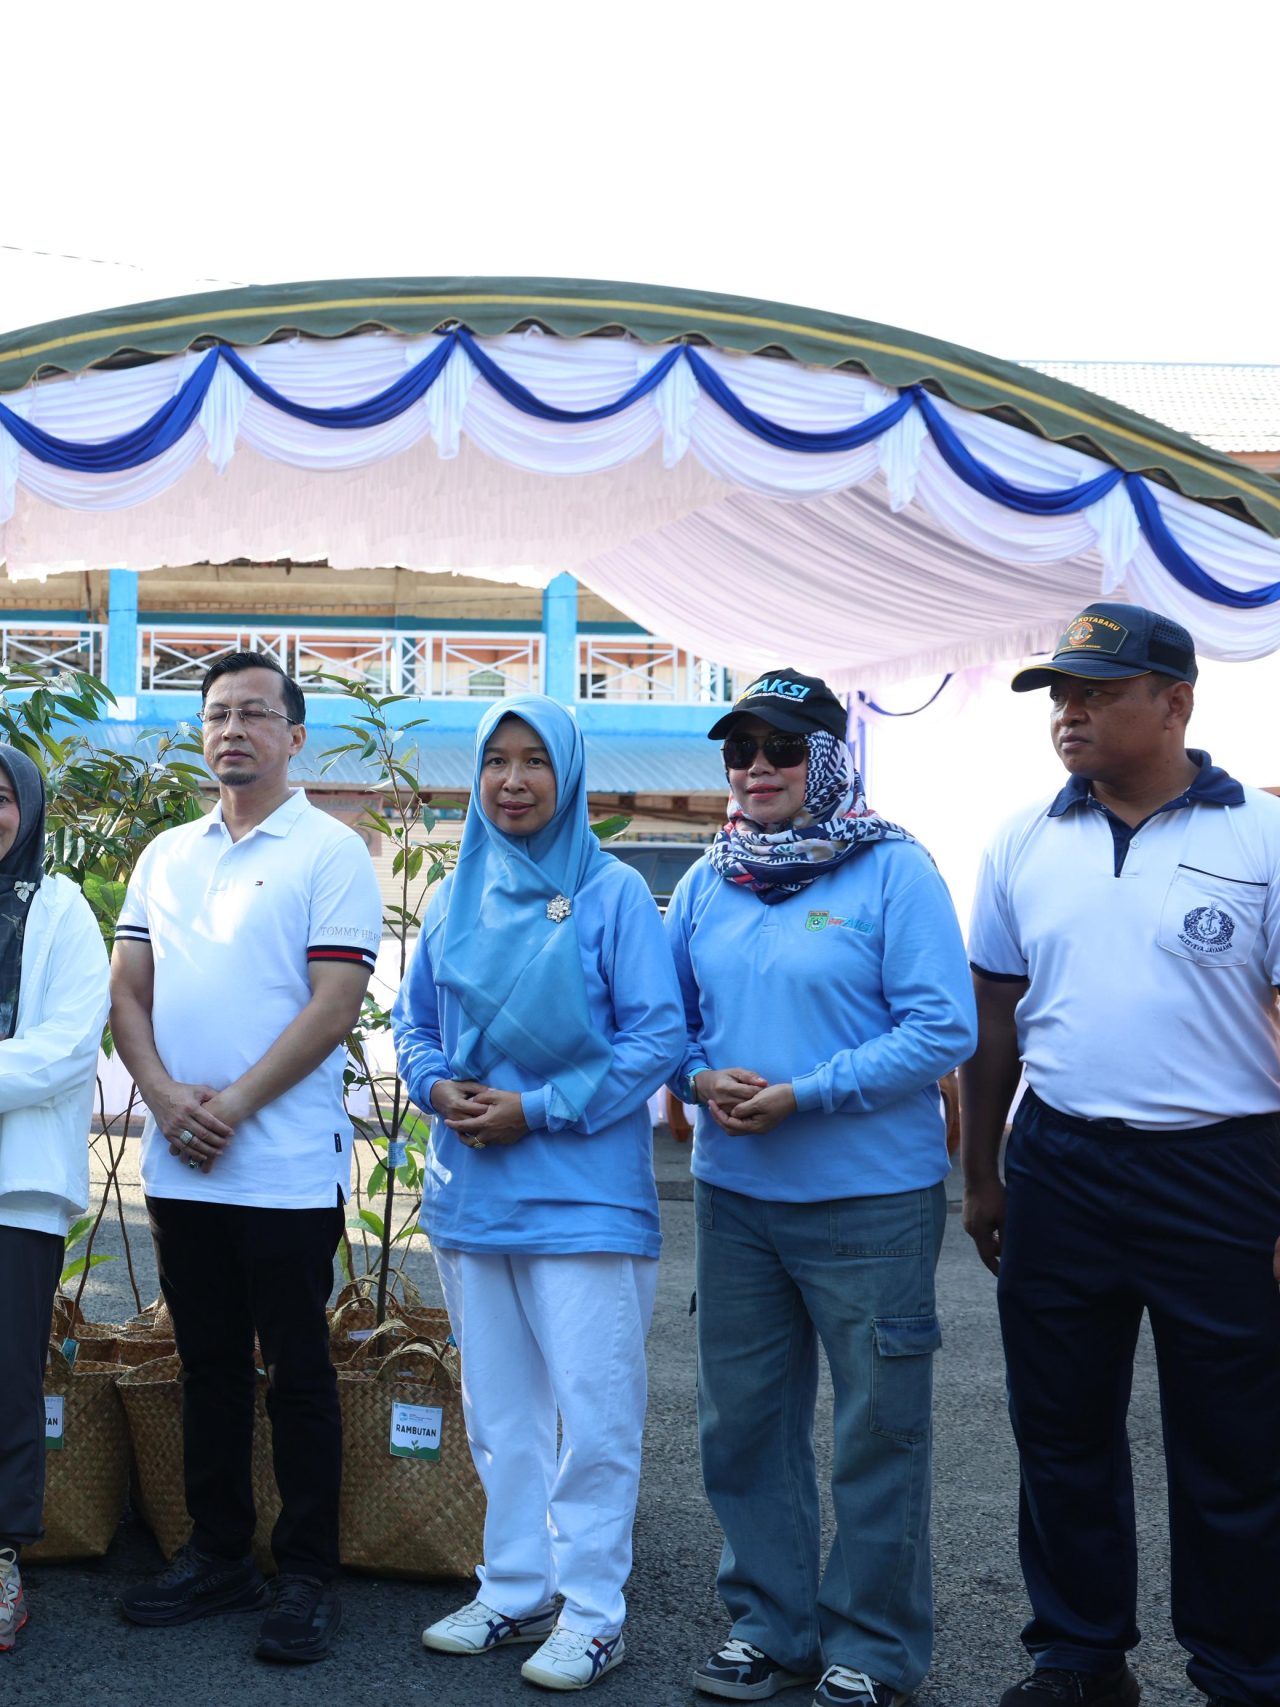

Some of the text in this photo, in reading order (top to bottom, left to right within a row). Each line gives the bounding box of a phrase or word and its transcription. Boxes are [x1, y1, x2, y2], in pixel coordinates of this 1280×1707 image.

[1078, 616, 1121, 631] KOTABARU
[320, 926, 359, 937] TOMMY
[396, 1424, 437, 1437] RAMBUTAN
